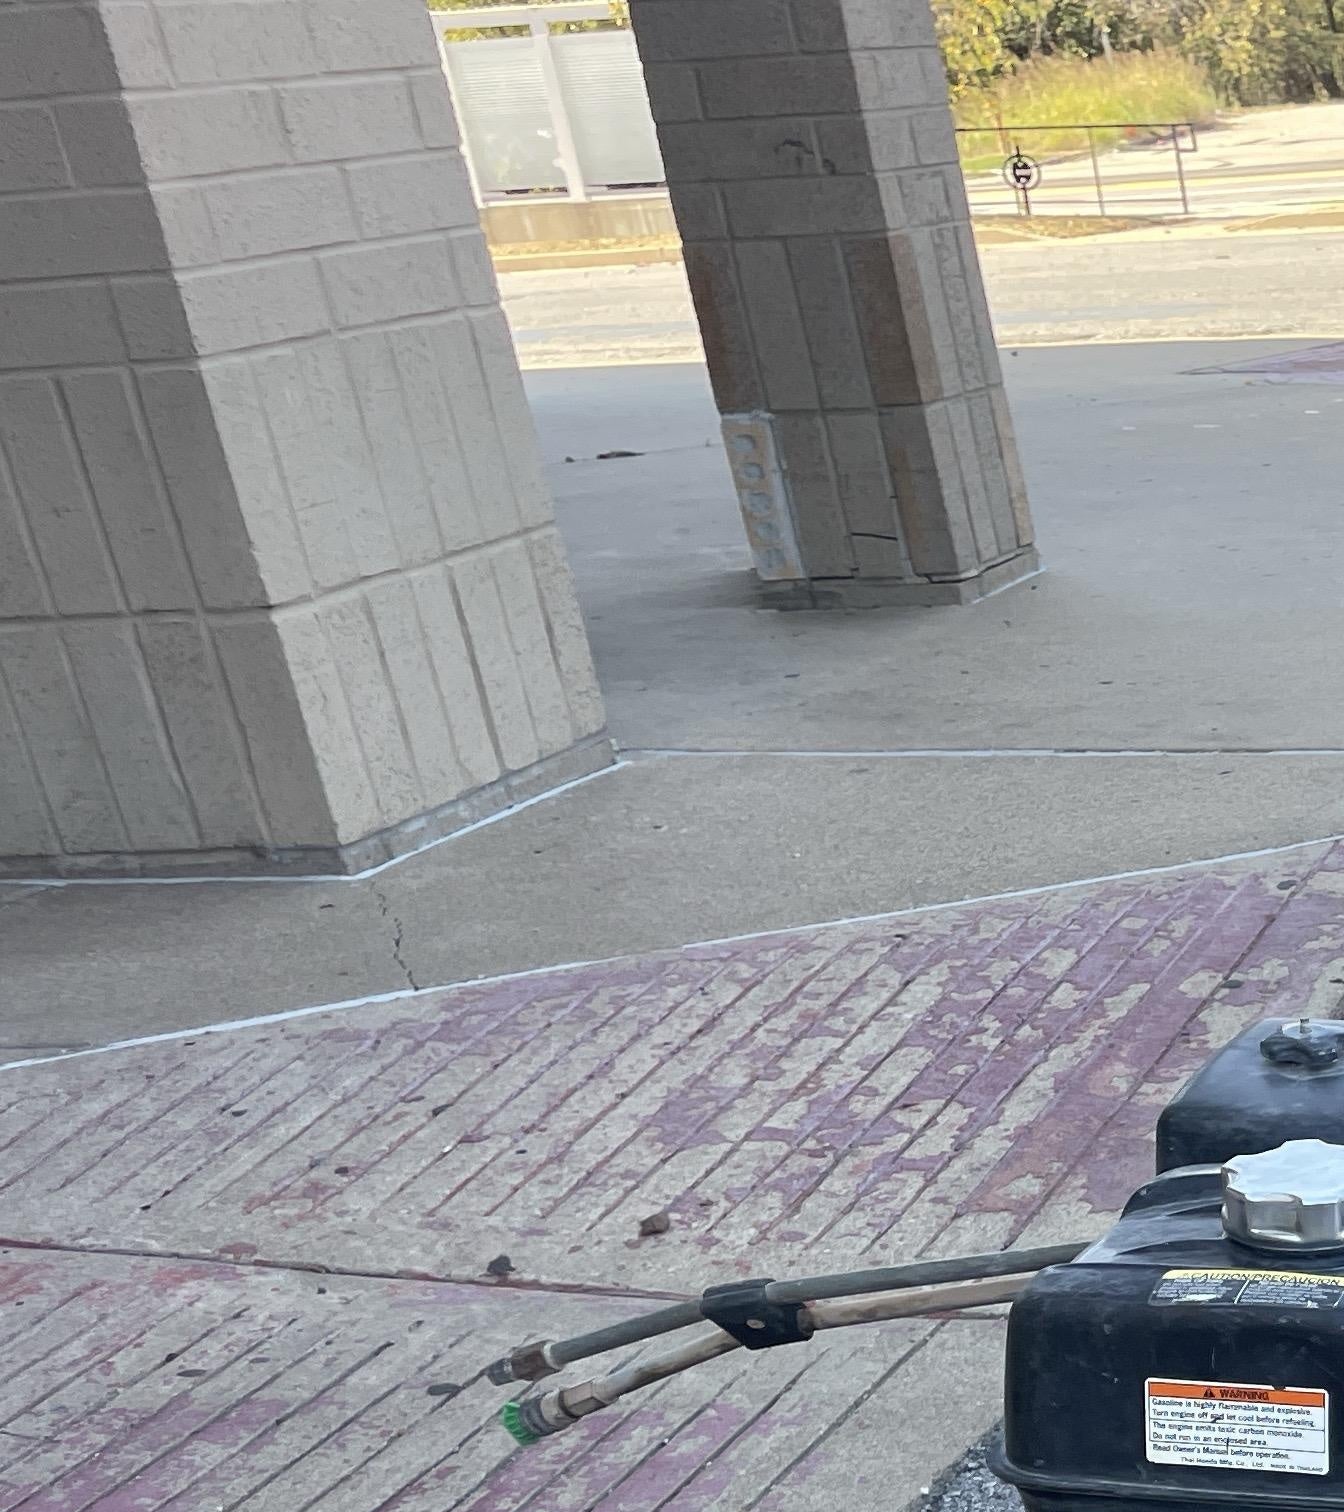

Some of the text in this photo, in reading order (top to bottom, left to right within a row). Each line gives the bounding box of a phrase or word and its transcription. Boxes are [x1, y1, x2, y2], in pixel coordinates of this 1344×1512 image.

[1219, 1388, 1270, 1401] WARNING
[1152, 1398, 1184, 1408] Gasoline
[1186, 1400, 1192, 1408] is
[1194, 1401, 1217, 1410] highly
[1152, 1408, 1169, 1417] Turn
[1171, 1411, 1195, 1419] engine
[1238, 1414, 1254, 1422] cool
[1256, 1415, 1280, 1424] before
[1153, 1421, 1166, 1429] The
[1168, 1423, 1193, 1431] engine
[1238, 1427, 1265, 1435] carbon
[1153, 1432, 1163, 1440] Do
[1152, 1443, 1171, 1452] Read
[1230, 1448, 1254, 1457] before
